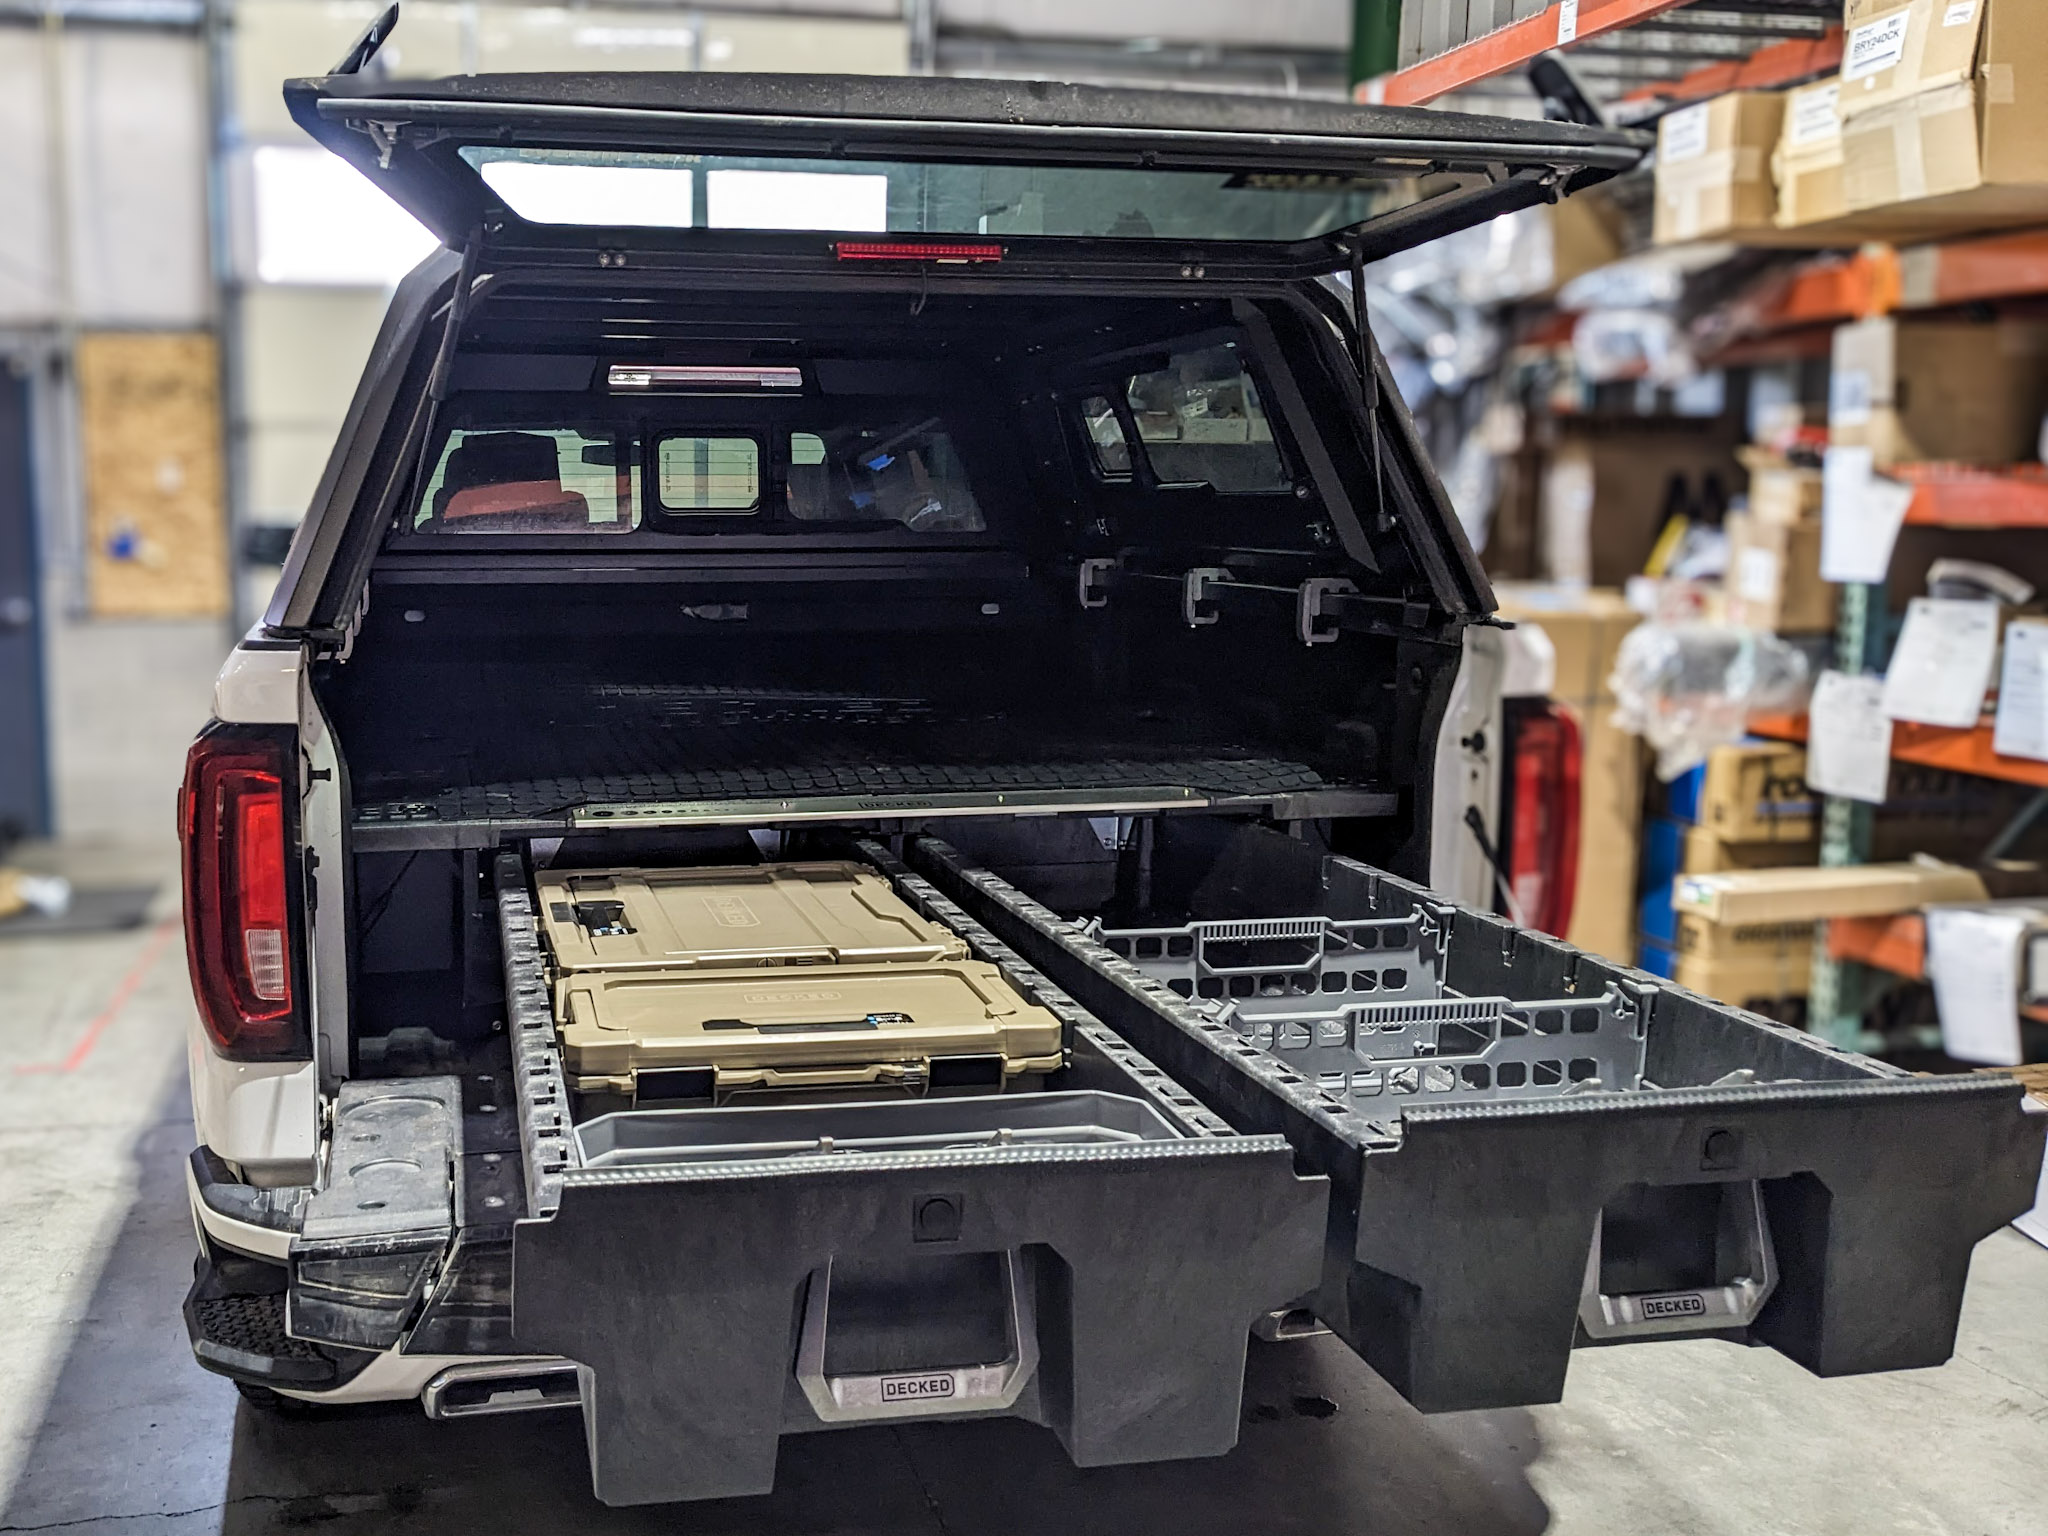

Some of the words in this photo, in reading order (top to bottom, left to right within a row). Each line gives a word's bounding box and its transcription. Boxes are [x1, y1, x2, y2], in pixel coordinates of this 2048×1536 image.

[1854, 28, 1900, 53] BRY24DCK
[1646, 1299, 1700, 1314] DECKED
[886, 1379, 950, 1396] DECKED
